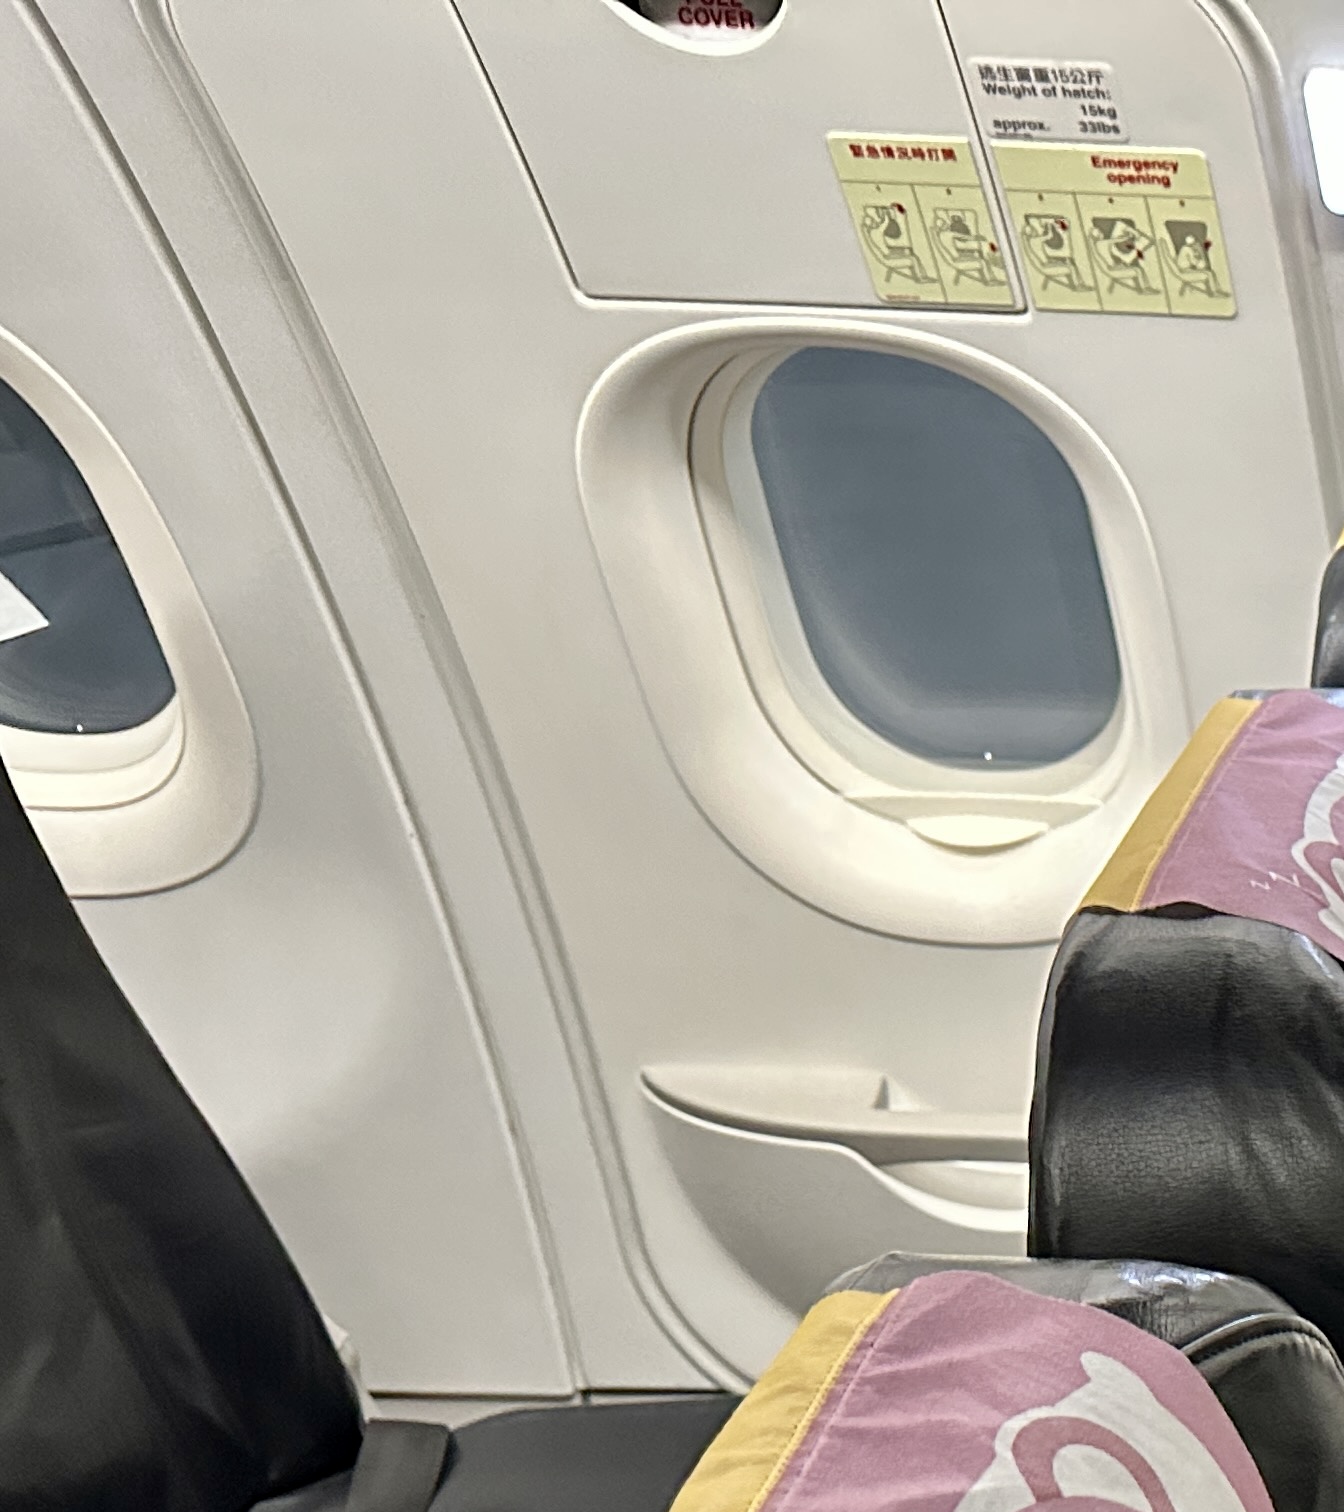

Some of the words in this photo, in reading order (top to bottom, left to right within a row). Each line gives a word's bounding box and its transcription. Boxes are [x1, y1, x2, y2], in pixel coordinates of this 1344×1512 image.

[678, 6, 755, 29] COVER
[982, 83, 1038, 99] Weight
[1042, 86, 1058, 98] of
[1061, 86, 1112, 100] hatch:
[1080, 104, 1117, 119] 15kg
[993, 118, 1050, 132] approx.
[1078, 120, 1121, 134] 33lbs
[1090, 155, 1179, 174] Emergency
[1106, 171, 1172, 187] opening
